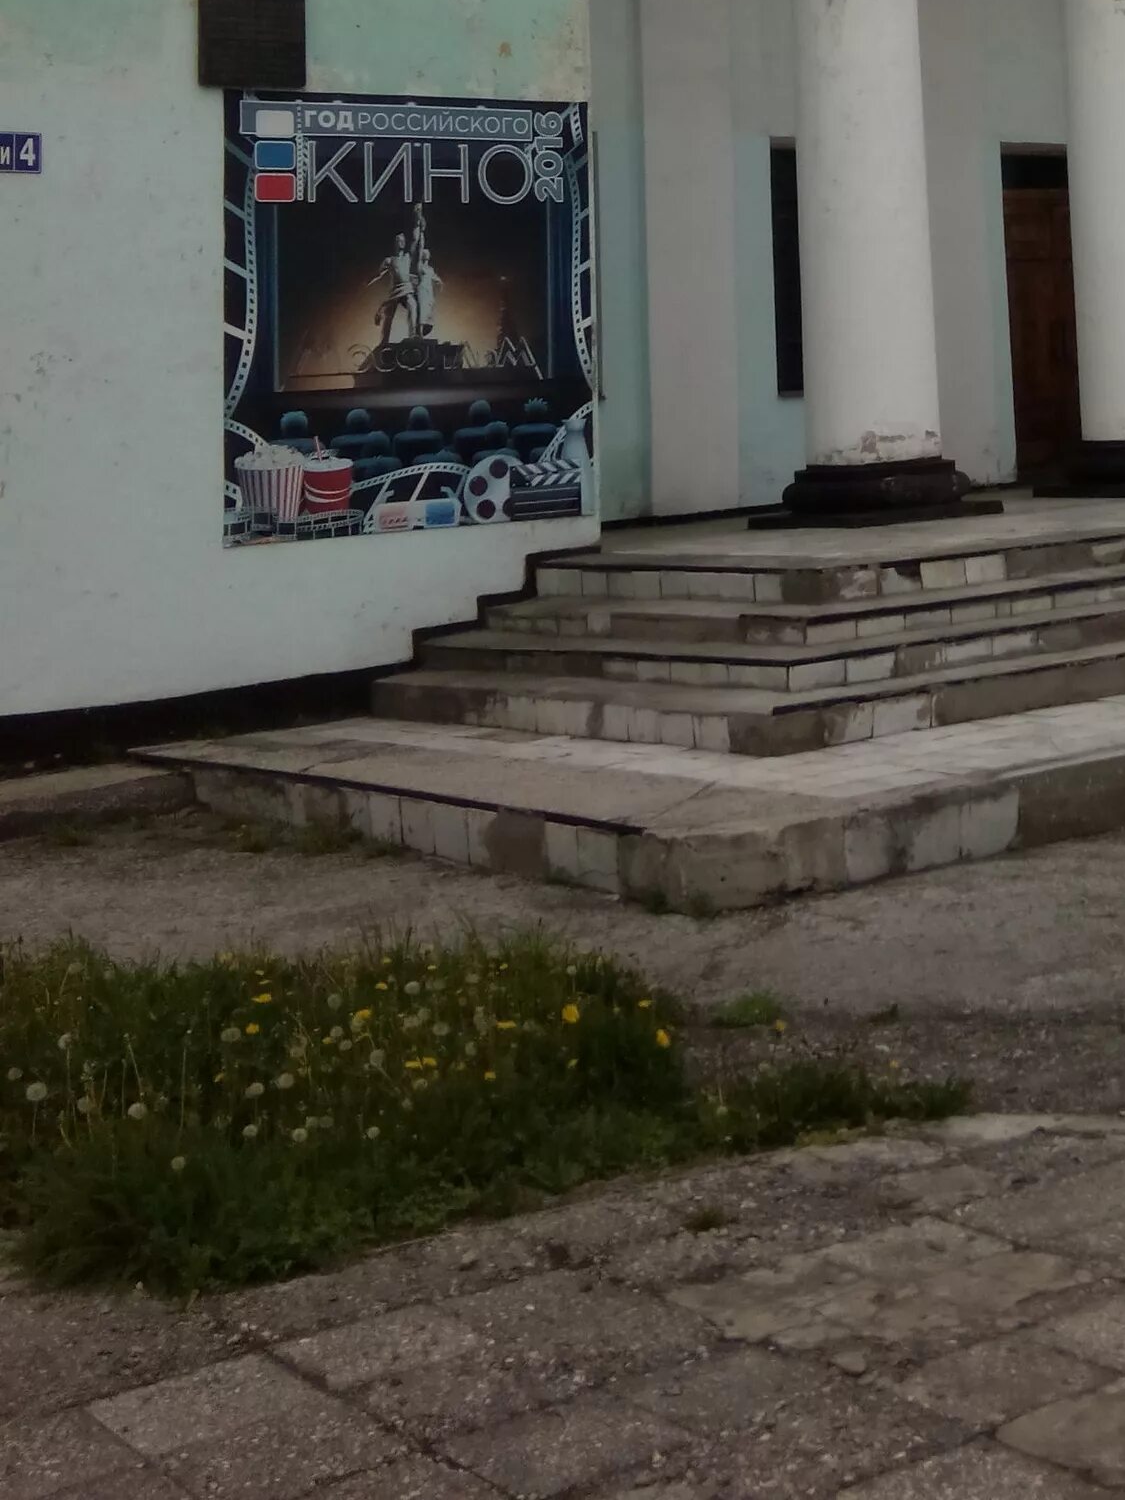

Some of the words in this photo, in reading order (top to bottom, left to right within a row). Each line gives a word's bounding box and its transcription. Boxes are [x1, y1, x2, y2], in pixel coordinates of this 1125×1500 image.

[304, 109, 354, 131] ГОД
[357, 111, 529, 135] РОССИЙСКОГО
[306, 140, 534, 205] КИНО
[534, 111, 564, 202] 2016
